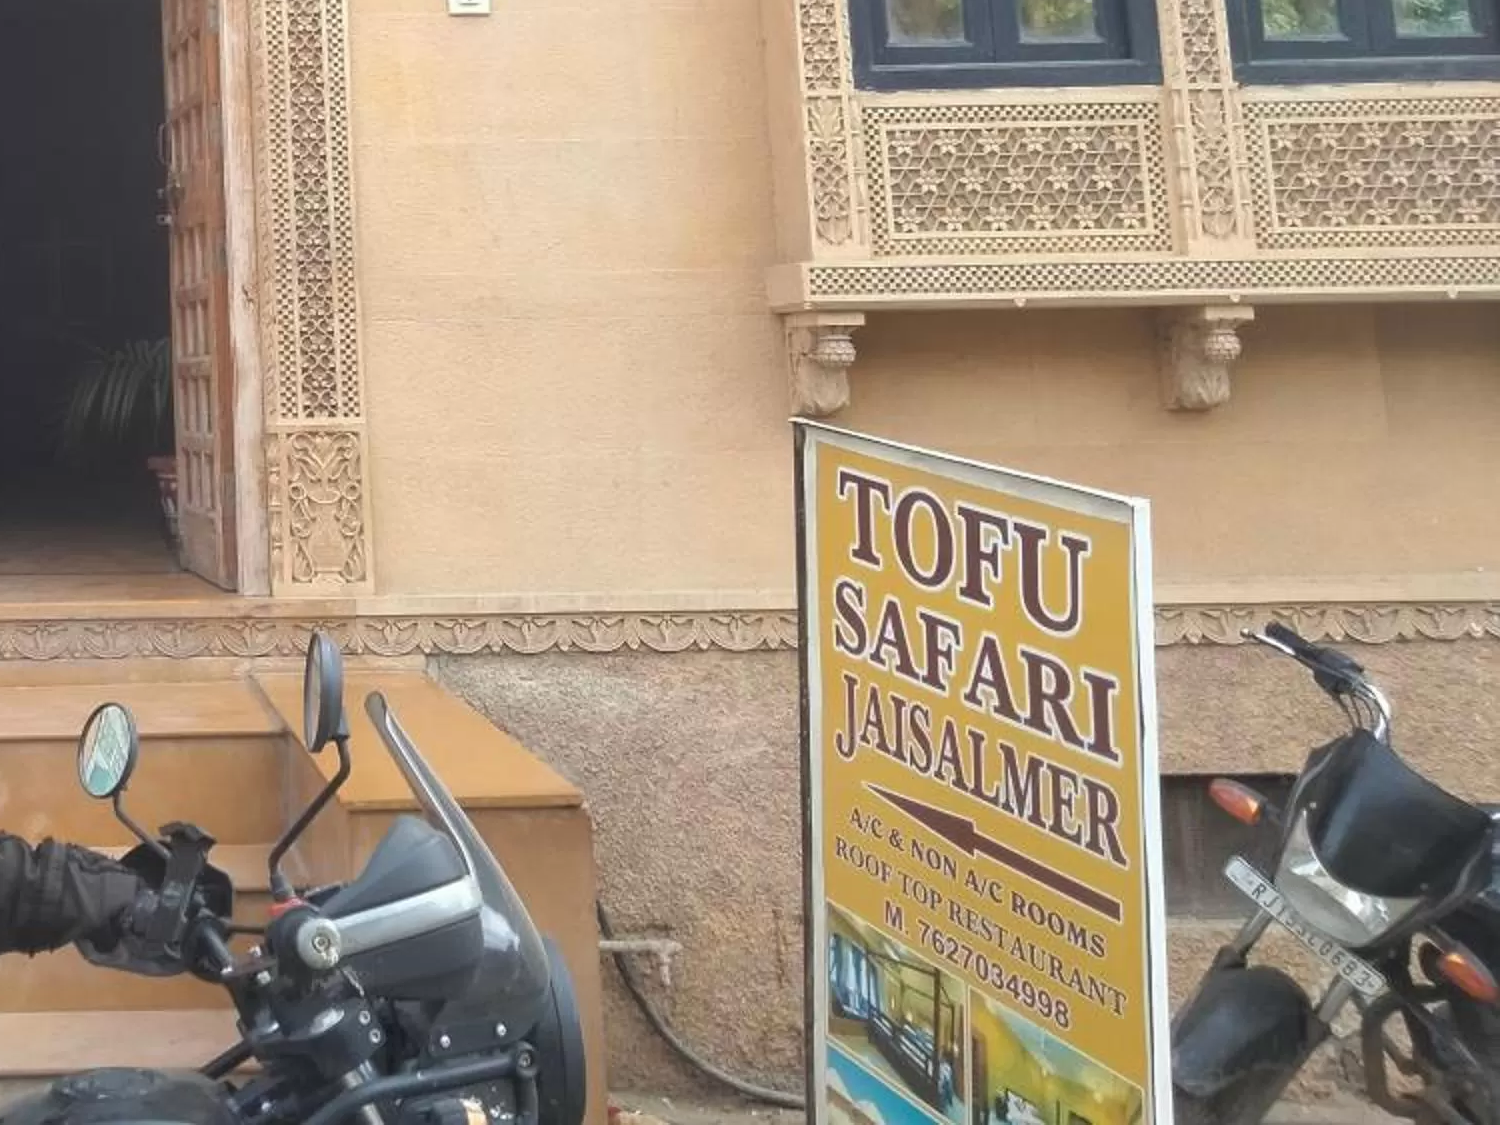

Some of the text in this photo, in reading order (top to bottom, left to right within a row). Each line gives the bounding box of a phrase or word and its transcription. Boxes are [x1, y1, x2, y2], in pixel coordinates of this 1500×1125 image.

[838, 469, 1090, 636] TOFU
[834, 579, 1122, 766] SAFARI
[836, 674, 1129, 869] JAISALMER
[835, 836, 1127, 1018] ROOF TOP RESTAURANT
[850, 807, 1106, 959] A/C & NON A/C ROOMS
[884, 900, 1070, 1029] M. 7627034998
